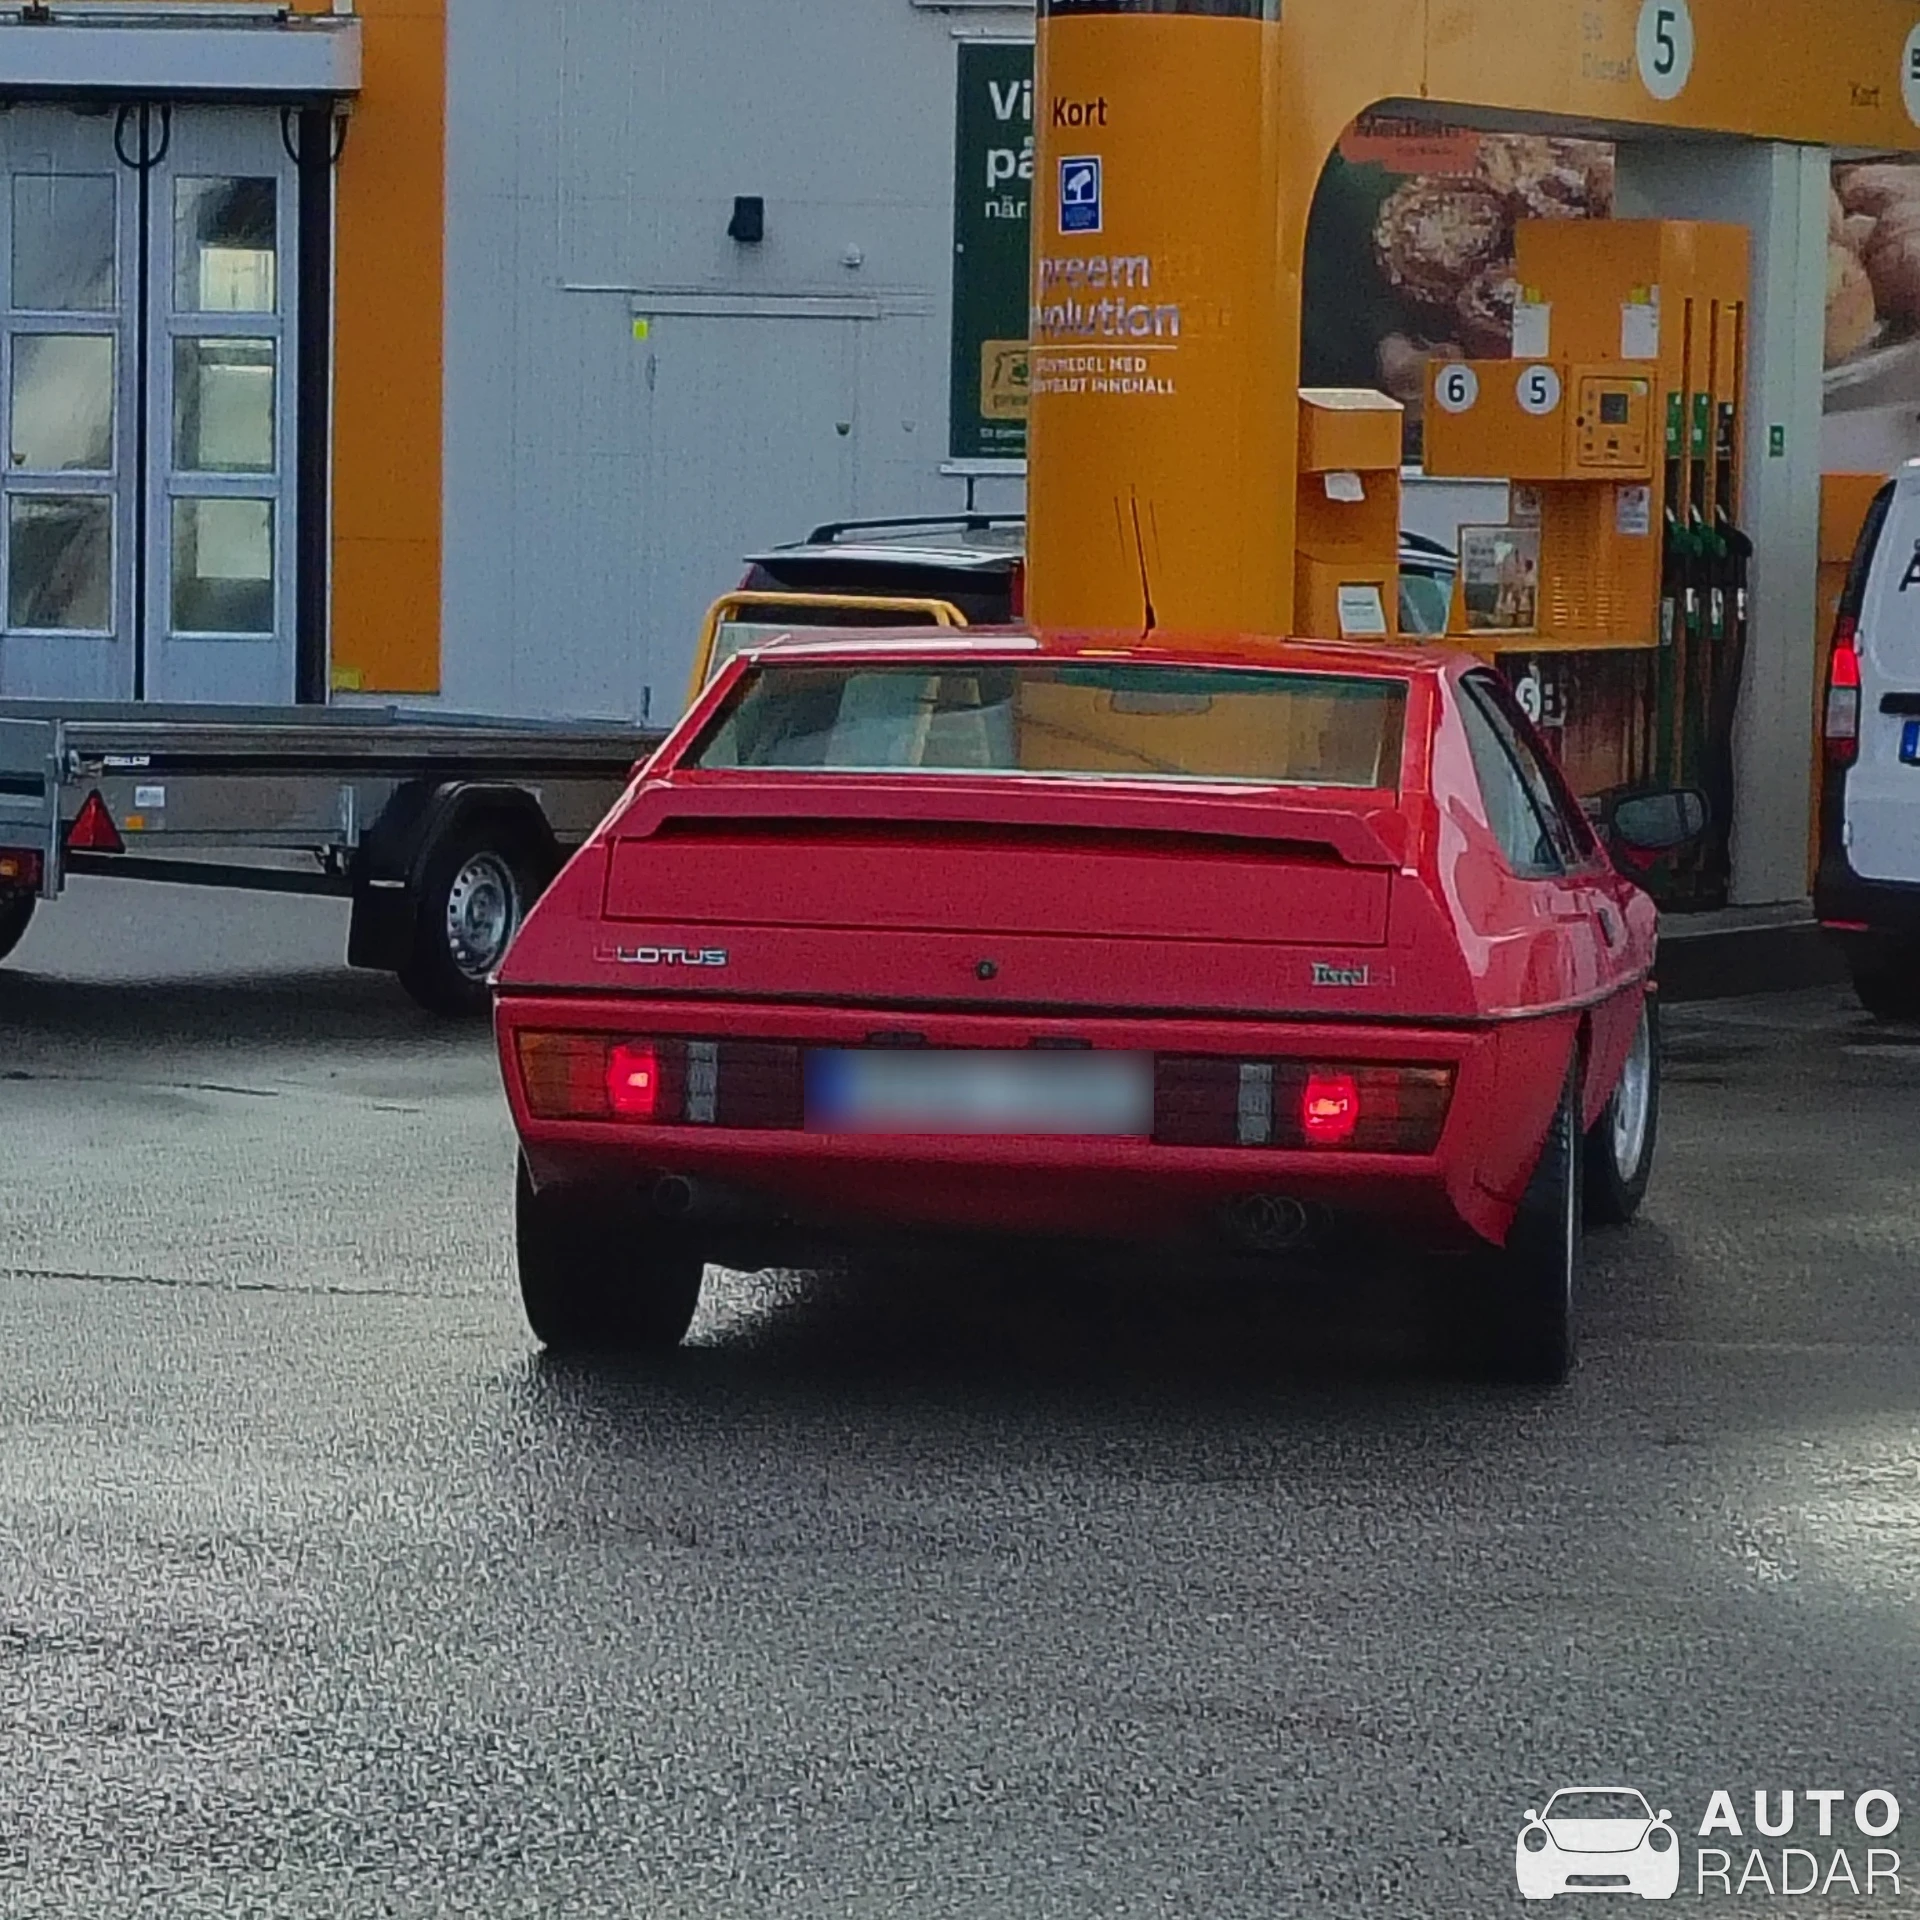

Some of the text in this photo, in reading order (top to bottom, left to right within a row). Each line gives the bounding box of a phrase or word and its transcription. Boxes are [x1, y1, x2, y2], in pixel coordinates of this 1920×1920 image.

[1654, 9, 1675, 74] 5
[988, 79, 1032, 120] Vi
[1053, 97, 1108, 127] Kort
[1447, 374, 1465, 403] 6
[1530, 376, 1546, 404] 5
[616, 946, 728, 966] LOTUS
